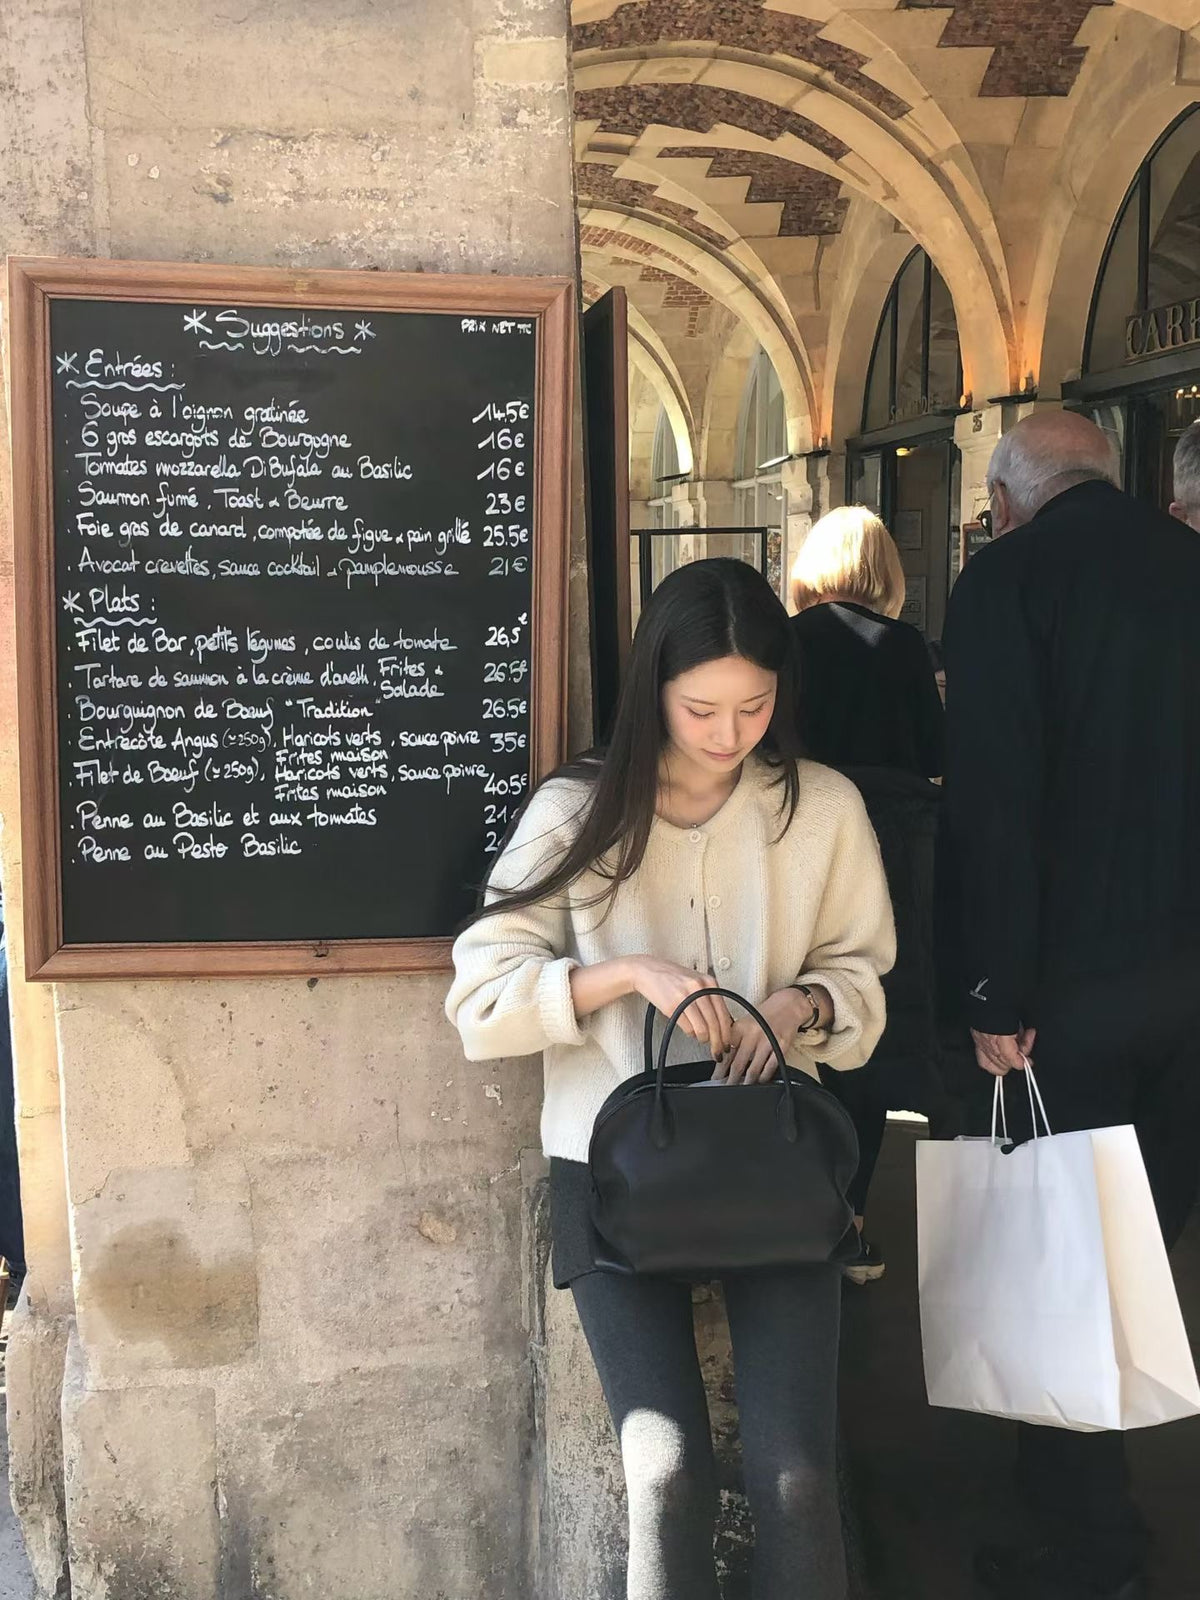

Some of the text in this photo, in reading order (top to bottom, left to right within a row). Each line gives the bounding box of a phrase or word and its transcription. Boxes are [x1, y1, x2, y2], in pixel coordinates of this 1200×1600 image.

[215, 309, 344, 356] Suggestions
[492, 320, 516, 334] NET
[80, 392, 142, 426] Soupe
[149, 398, 162, 419] à
[172, 394, 233, 433] l'oignon
[241, 397, 309, 436] gratinée
[81, 421, 525, 459] 6 gros escargots de Bourgogne 16€
[75, 452, 147, 476] Tomates
[156, 454, 241, 478] mozzarella
[331, 466, 352, 479] au
[357, 455, 413, 480] Basilic
[476, 457, 525, 480] 16€
[78, 480, 150, 507] Saumon
[213, 487, 264, 509] Toast
[284, 487, 349, 511] Beurre
[485, 492, 526, 515] 23€
[76, 511, 114, 537] Foie
[118, 520, 150, 548] gras
[159, 513, 183, 537] de
[258, 518, 324, 549] compotée
[327, 519, 348, 541] de
[348, 517, 393, 554] figue
[406, 527, 432, 552] pain
[435, 516, 472, 555] grillé
[78, 545, 141, 574] Avocat
[220, 558, 261, 577] sauce
[267, 551, 320, 577] cocktail
[338, 553, 460, 590] pamplemousse
[488, 556, 528, 577] 21€
[75, 627, 121, 653] Filet
[127, 632, 149, 654] de
[194, 624, 239, 665] petits
[312, 630, 361, 651] coulis
[368, 628, 390, 651] de
[393, 627, 458, 651] tomate
[74, 662, 142, 689] Tartare
[148, 665, 168, 688] de
[173, 670, 229, 688] saumon
[236, 665, 248, 685] à
[252, 664, 269, 685] la
[271, 665, 314, 686] crème
[378, 656, 426, 678] Frites
[380, 678, 445, 700] Salade
[75, 694, 185, 733] Bourguignon
[194, 696, 218, 720] de
[78, 726, 166, 752] Entrecôte
[171, 727, 219, 759] Angus
[283, 723, 342, 747] Haricots
[399, 730, 439, 747] sauce
[440, 730, 481, 757] poivre
[490, 731, 527, 753] 35€
[275, 748, 388, 766] Frites maison
[73, 759, 120, 787] Filet
[123, 767, 144, 785] de
[274, 762, 341, 782] Haricots
[398, 764, 442, 780] sauce
[442, 763, 490, 795] poivre
[483, 771, 528, 796] 40.5€
[274, 783, 387, 801] Frites maison
[76, 800, 134, 831] Penne
[143, 815, 166, 828] au
[172, 801, 234, 828] Basilic
[242, 802, 261, 827] et
[269, 810, 303, 826] aux
[306, 803, 378, 828] tomates
[78, 831, 505, 863] Penne au Pesto Basilic 2
